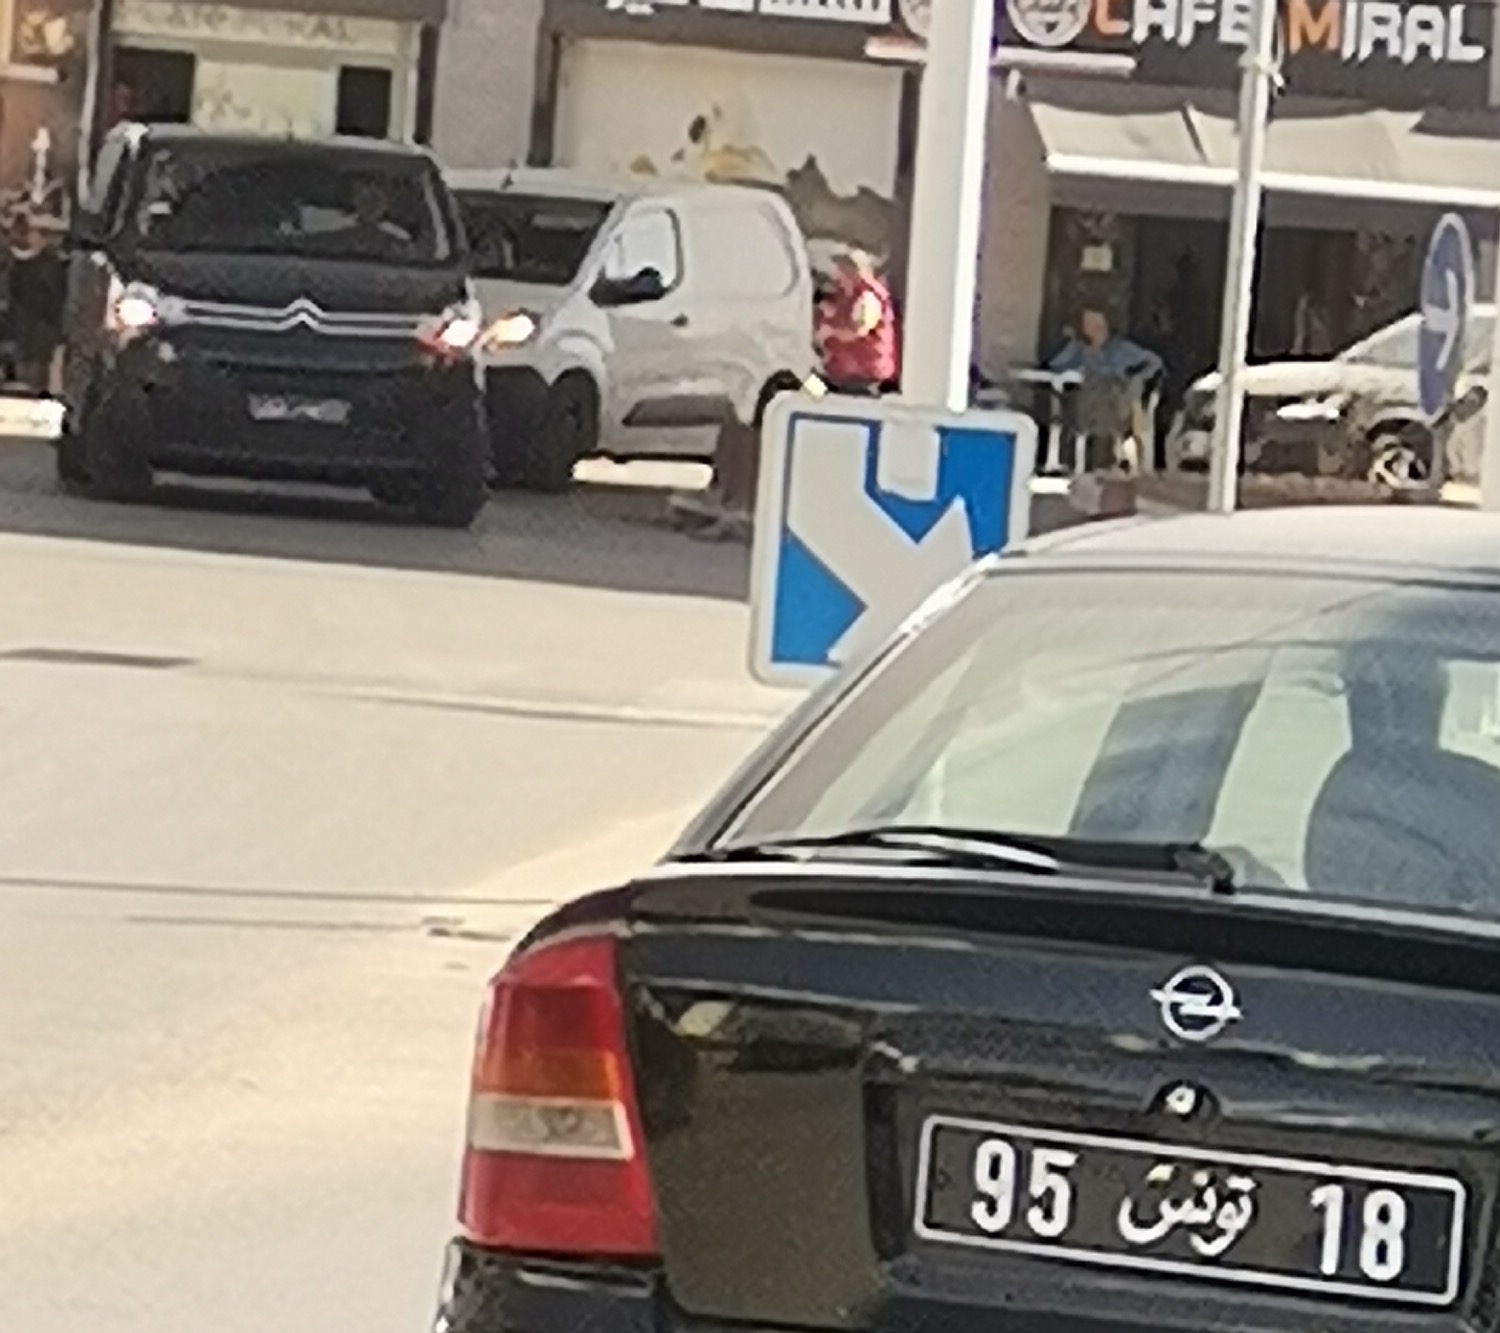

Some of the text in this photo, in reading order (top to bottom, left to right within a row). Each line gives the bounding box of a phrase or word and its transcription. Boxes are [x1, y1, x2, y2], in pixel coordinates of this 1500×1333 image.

[1092, 0, 1250, 43] CAFE
[1289, 1, 1485, 63] MIRAL
[971, 1138, 1406, 1281] 95 تونس 18
